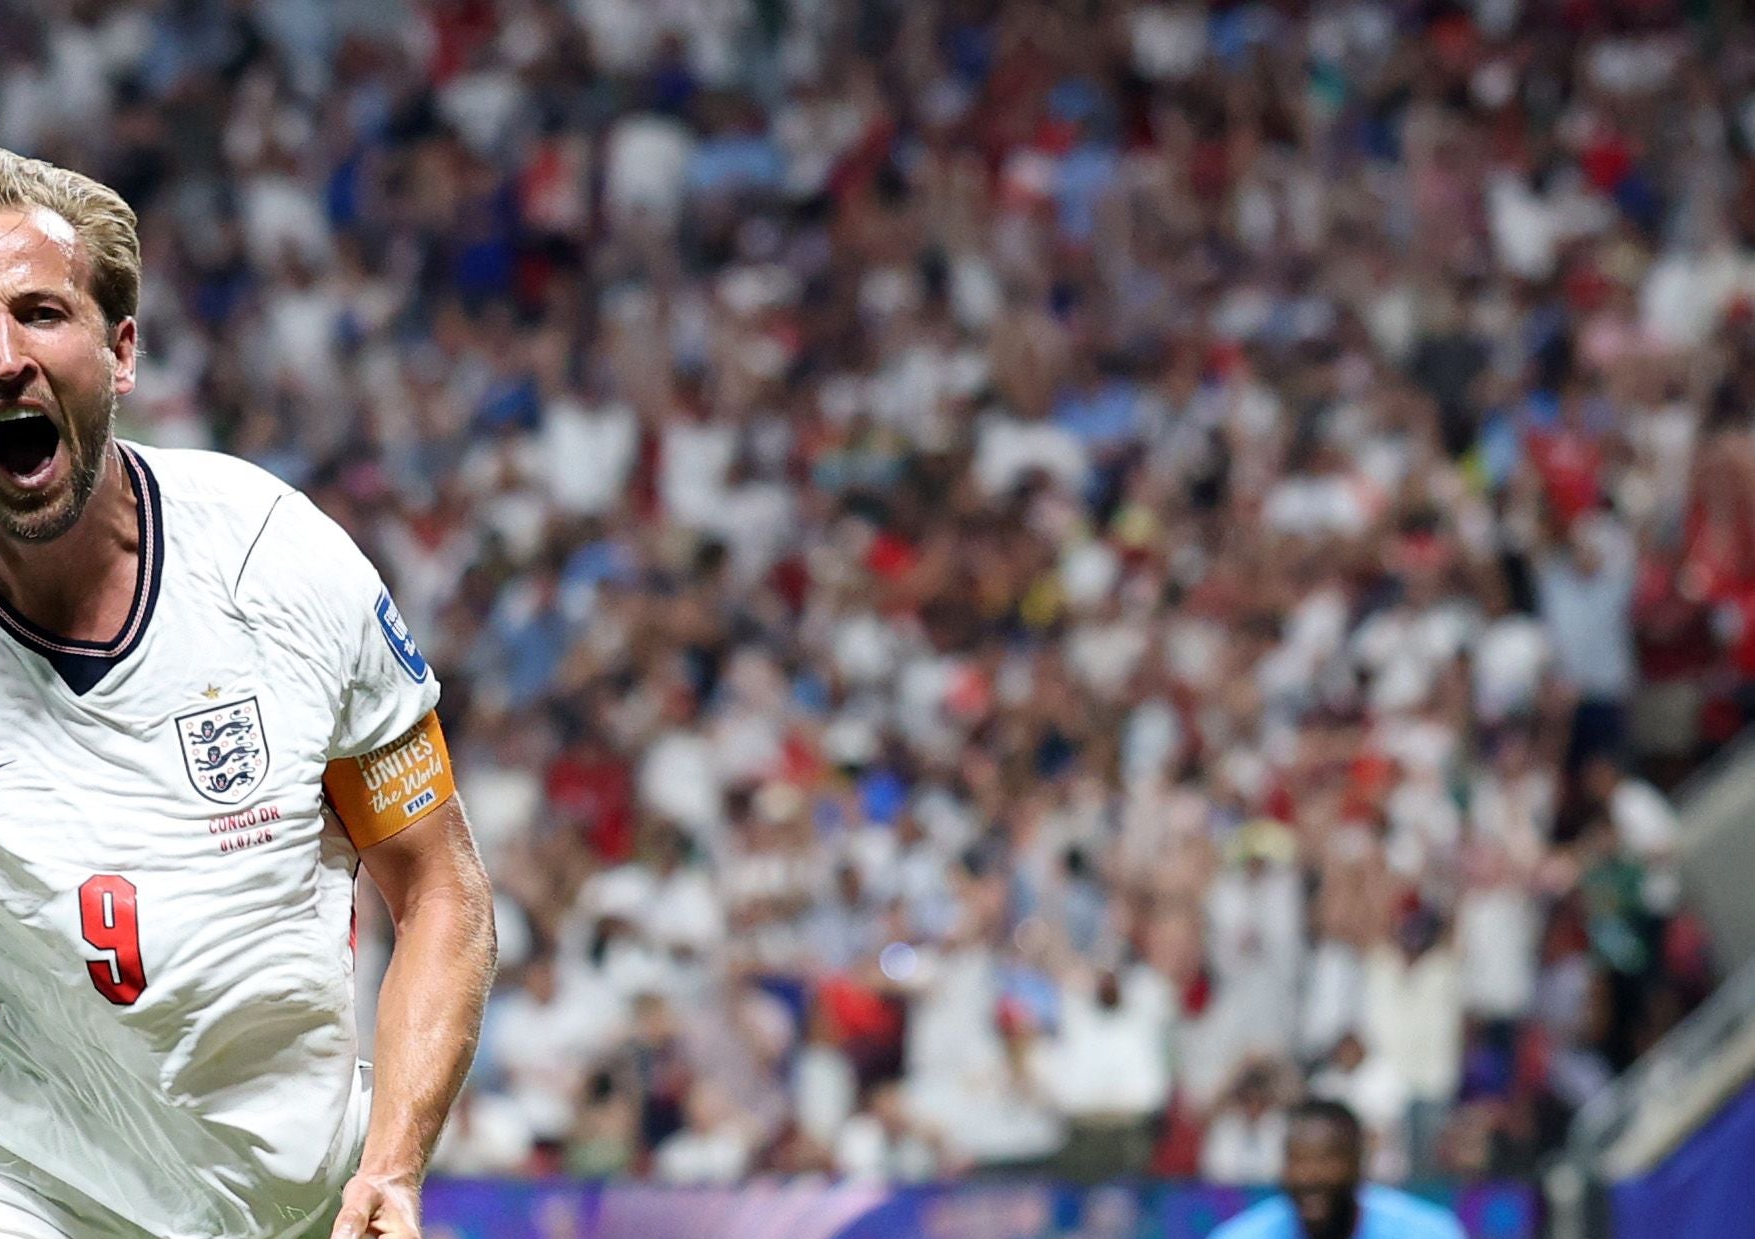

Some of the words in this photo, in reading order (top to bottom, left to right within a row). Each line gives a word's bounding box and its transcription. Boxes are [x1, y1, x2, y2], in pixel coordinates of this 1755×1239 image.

[361, 732, 433, 791] UNITES
[368, 789, 402, 814] the
[401, 752, 444, 796] World
[209, 808, 256, 834] CONGO
[259, 804, 281, 823] DR
[406, 791, 434, 813] FIFA
[220, 828, 273, 852] 01.07.26
[78, 874, 148, 1006] 9
